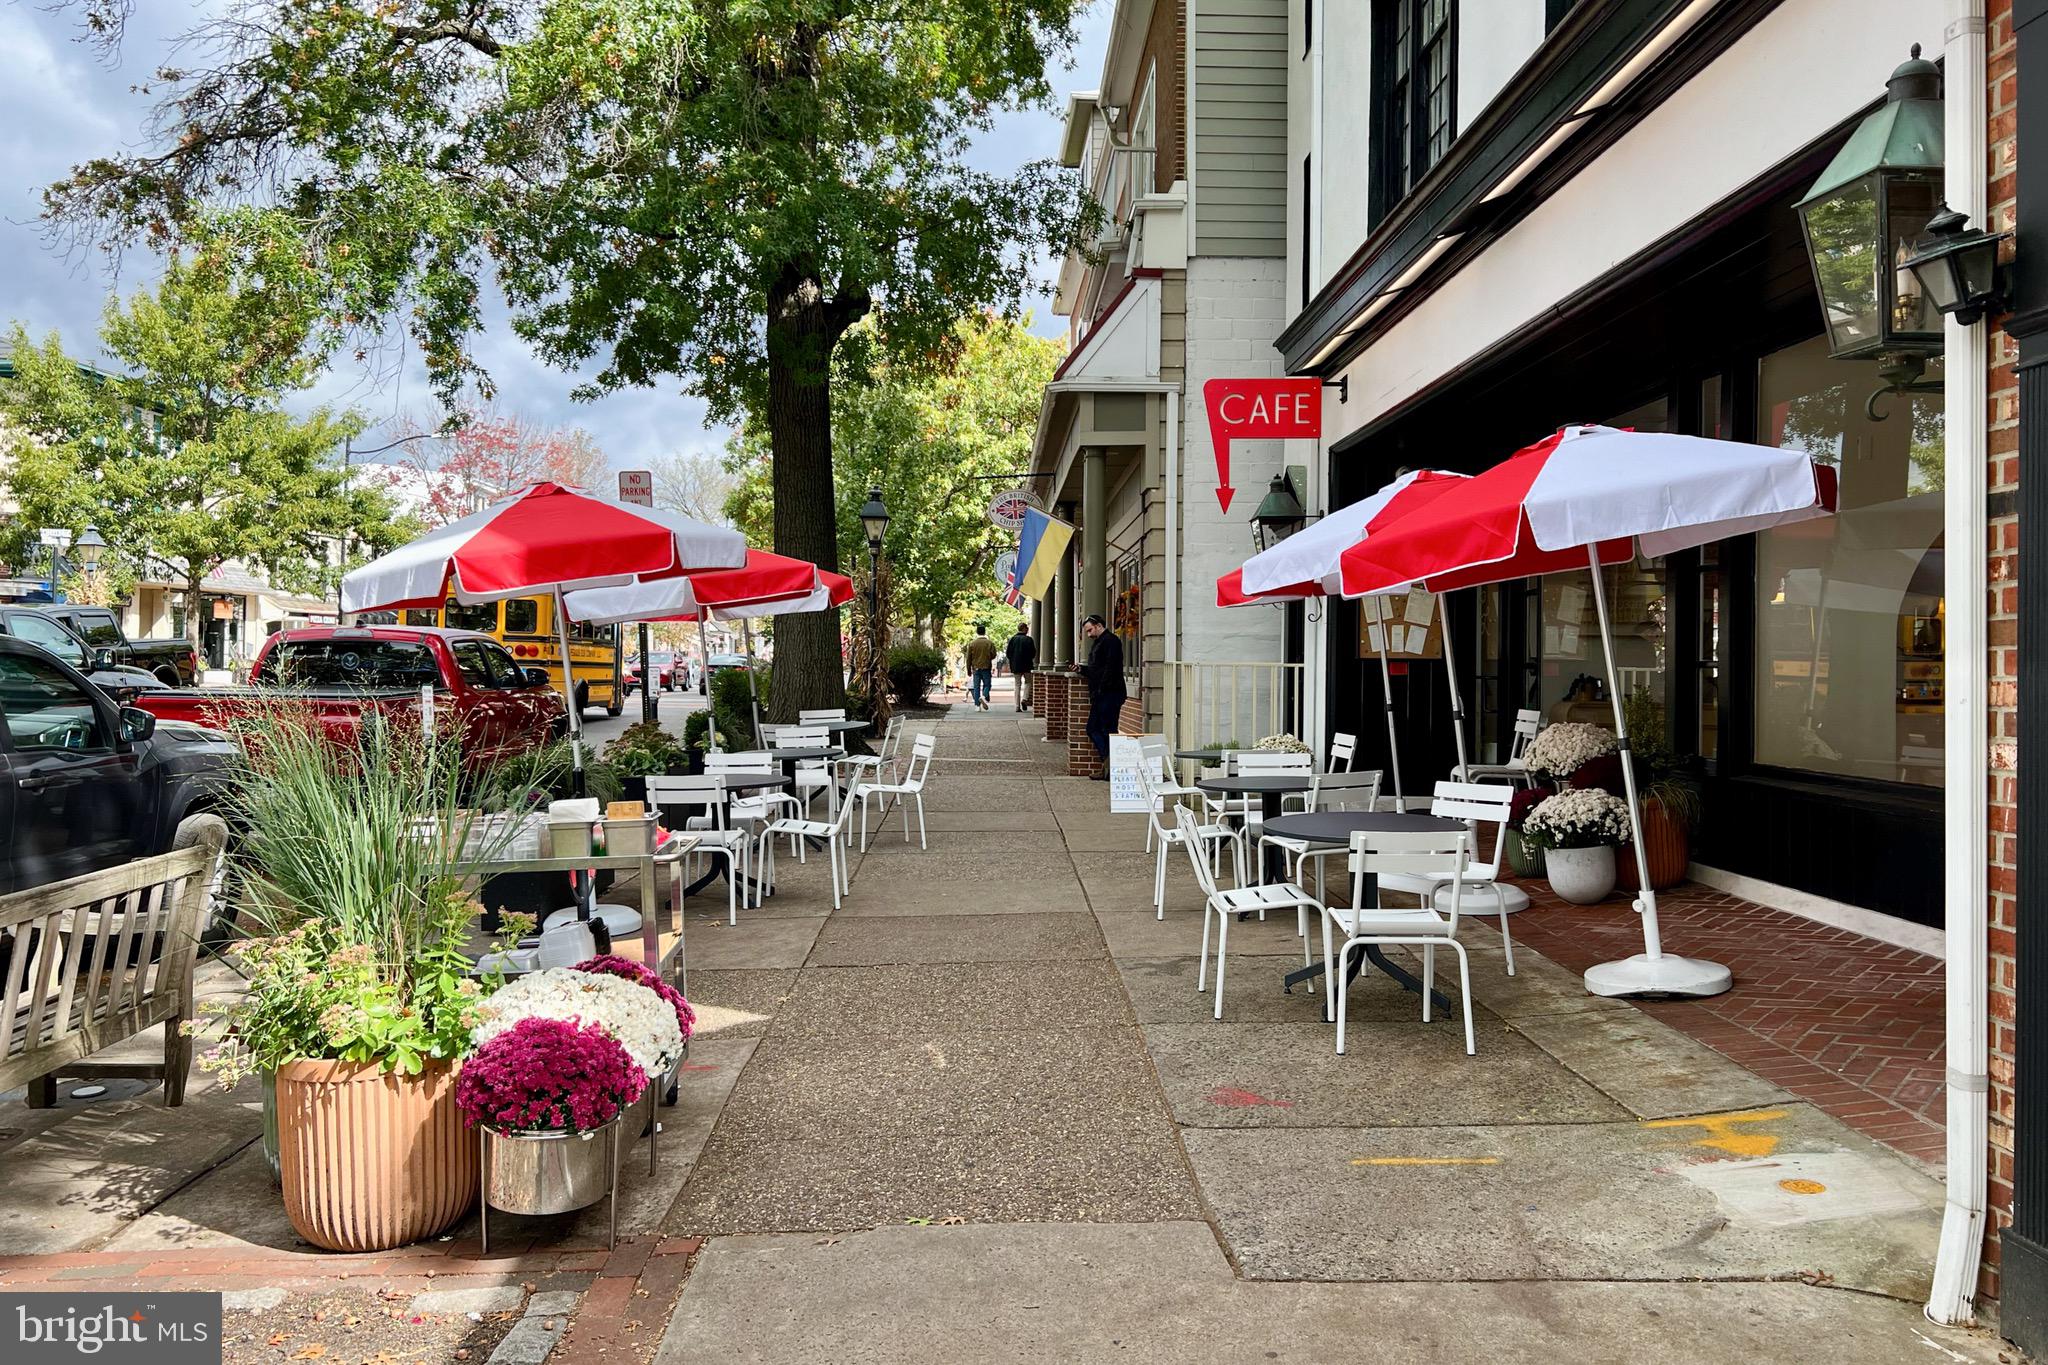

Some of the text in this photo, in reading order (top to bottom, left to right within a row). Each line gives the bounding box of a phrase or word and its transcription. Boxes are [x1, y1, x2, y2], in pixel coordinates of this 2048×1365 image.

[1219, 393, 1312, 425] CAFE
[629, 474, 641, 485] NO
[621, 487, 651, 496] PARKING
[995, 493, 1034, 505] THE BRITISH
[1000, 518, 1015, 526] CHIP
